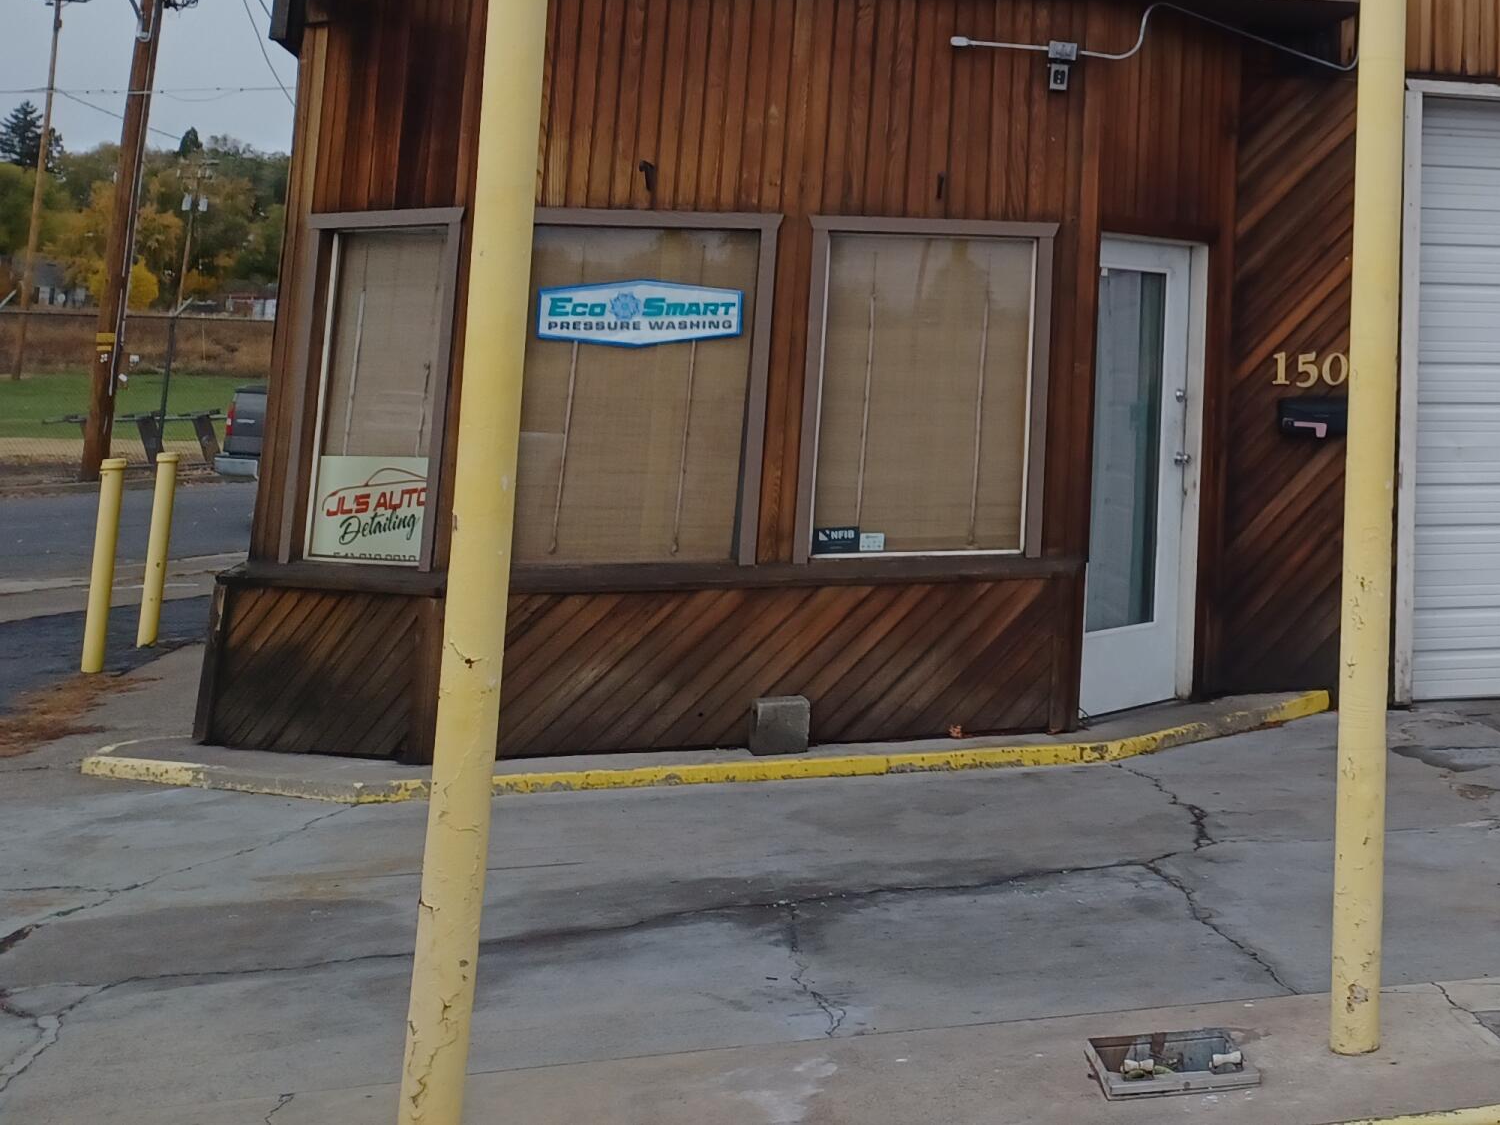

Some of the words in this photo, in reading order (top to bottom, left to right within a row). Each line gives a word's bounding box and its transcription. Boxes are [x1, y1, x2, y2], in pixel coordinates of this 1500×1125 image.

[548, 321, 641, 331] PRESSURE
[649, 320, 733, 330] WASHING
[373, 488, 427, 512] AUTO
[339, 511, 420, 545] Detailing
